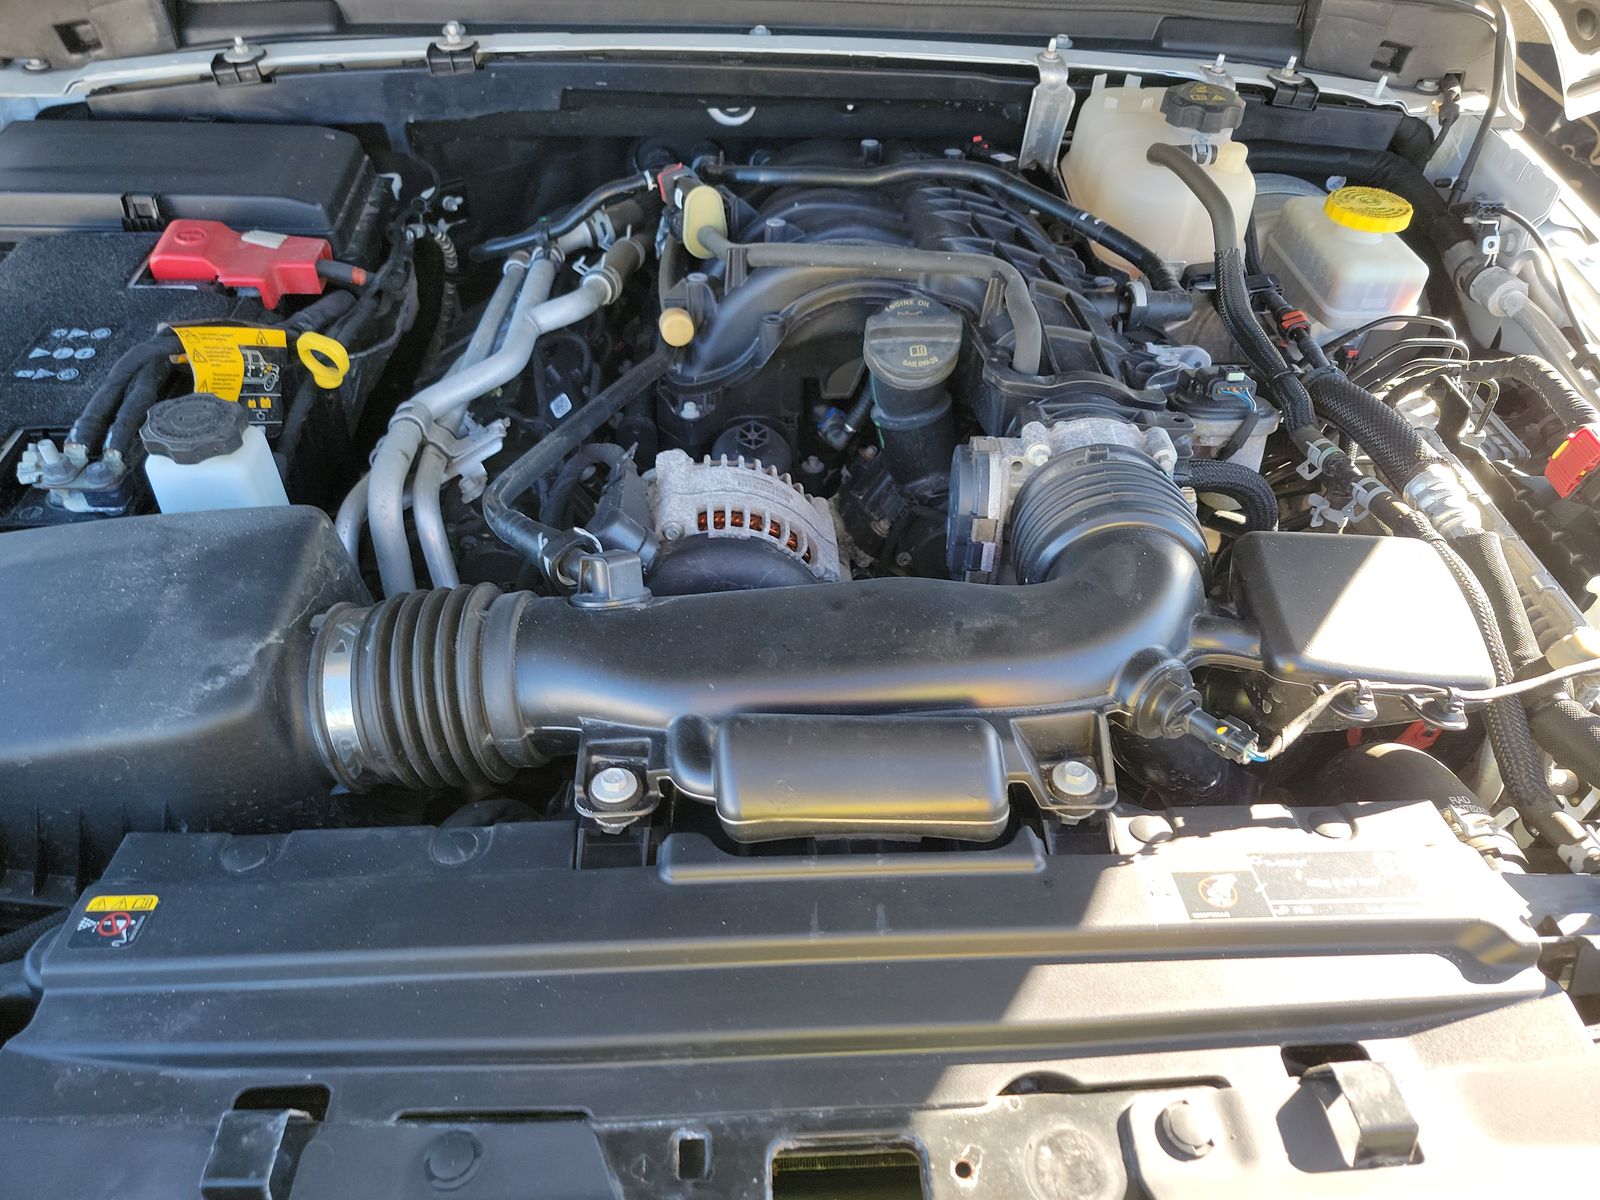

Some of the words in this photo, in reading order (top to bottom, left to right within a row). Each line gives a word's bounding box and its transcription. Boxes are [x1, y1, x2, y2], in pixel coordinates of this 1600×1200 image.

[885, 299, 912, 312] ENGINE
[918, 300, 929, 308] OIL
[902, 359, 917, 367] SAE
[1448, 796, 1471, 804] RAD
